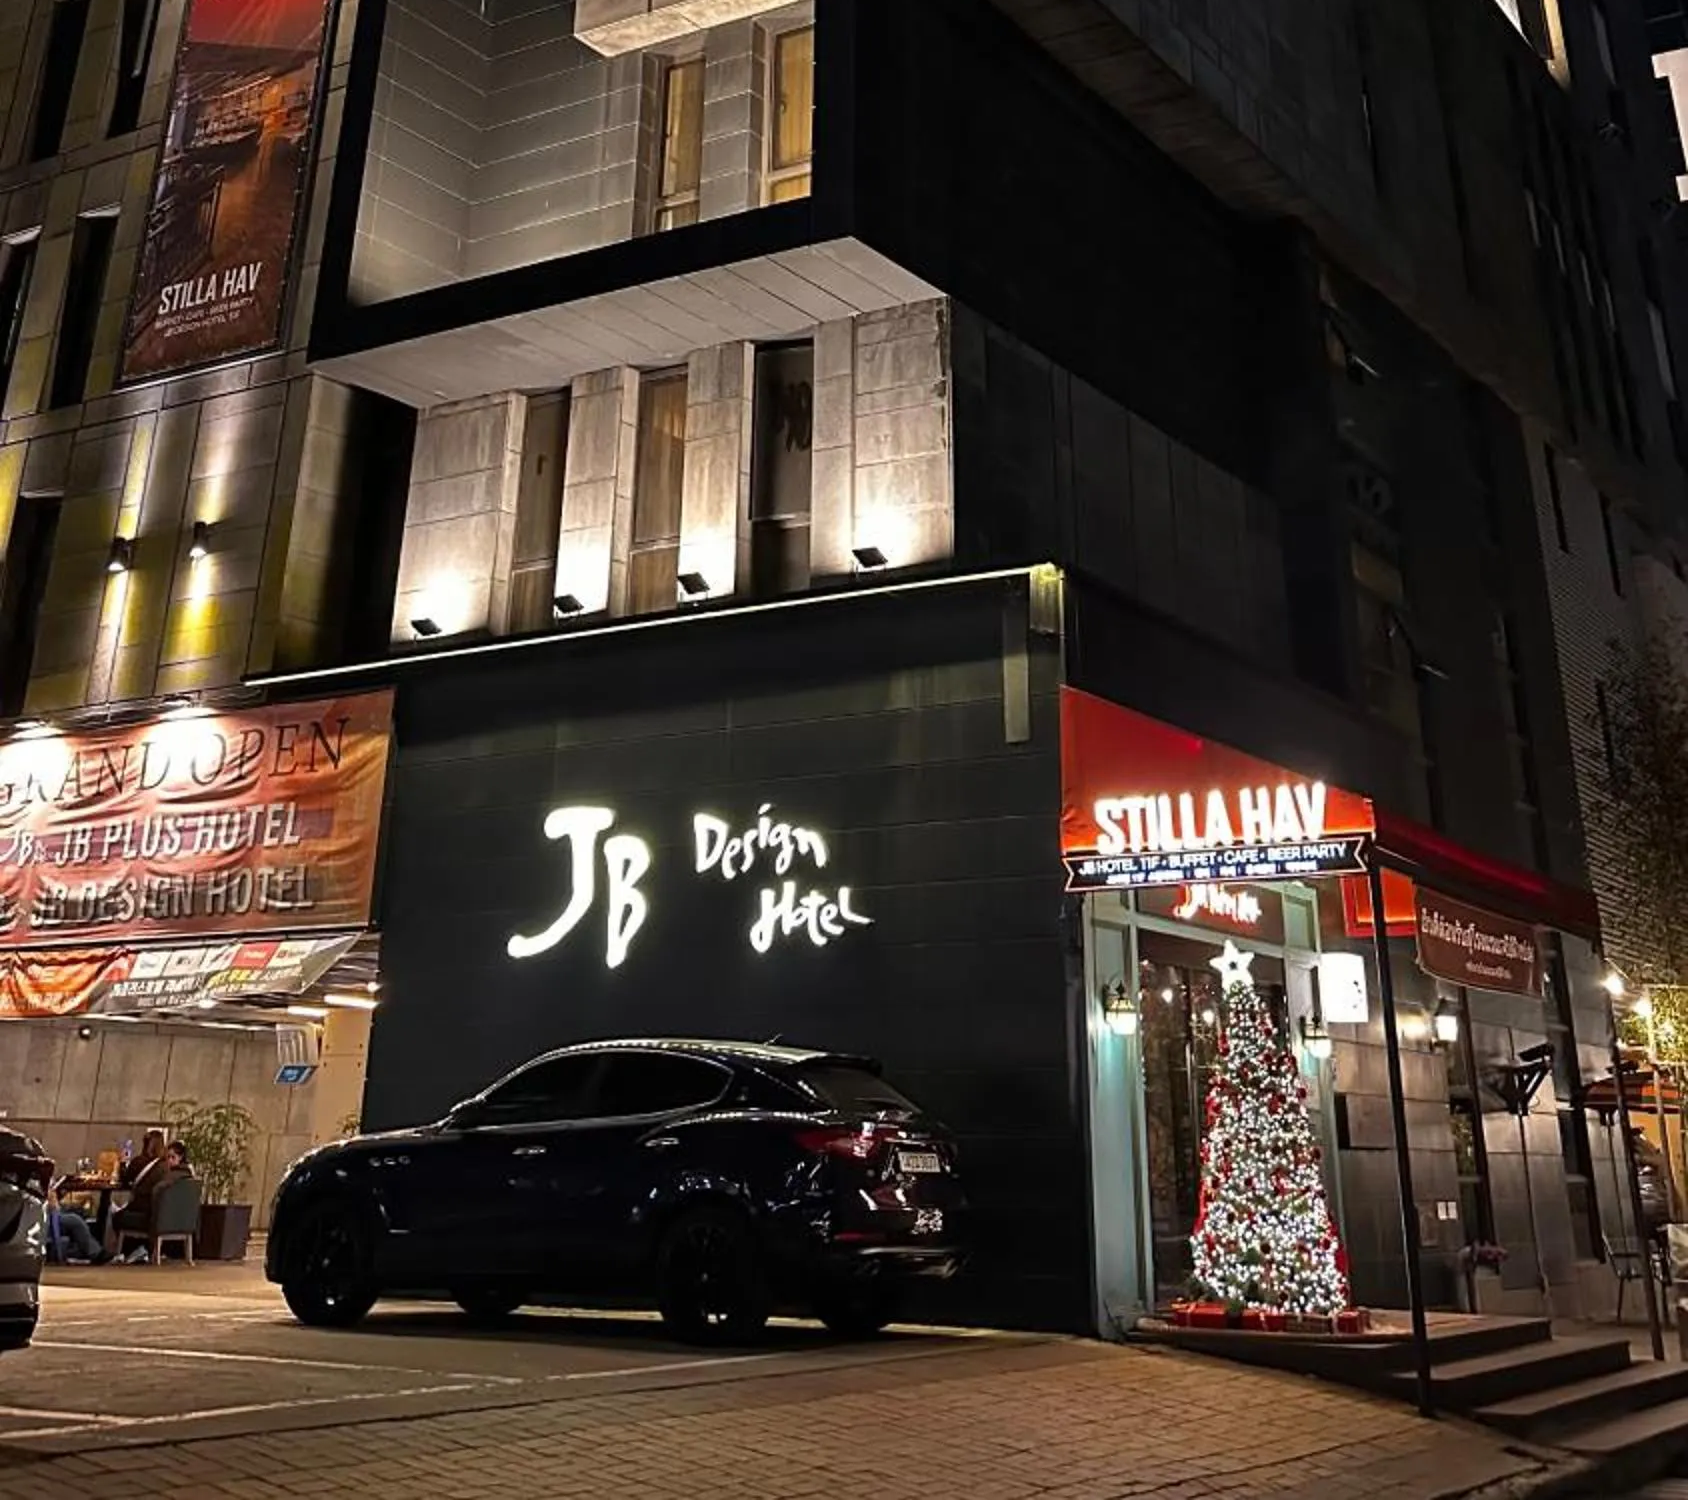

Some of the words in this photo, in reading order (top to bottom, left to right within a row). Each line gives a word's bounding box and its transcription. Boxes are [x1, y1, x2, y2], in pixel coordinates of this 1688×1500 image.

[157, 273, 217, 315] STILLA
[221, 260, 263, 299] HAV
[0, 742, 172, 805] AND
[190, 716, 350, 787] OPEN
[55, 827, 93, 868] JB
[101, 815, 183, 865] PLUS
[193, 801, 300, 855] HOTEL
[1094, 789, 1234, 856] STILLA
[1238, 779, 1326, 845] HAV
[204, 862, 314, 915] HOTEL
[505, 804, 653, 970] JB
[692, 802, 828, 880] Design
[1096, 857, 1138, 873] HOTEL
[1168, 851, 1217, 869] BUFFET
[1223, 848, 1260, 864] CAFE
[1267, 846, 1301, 861] BEER
[1302, 843, 1347, 859] PARTY
